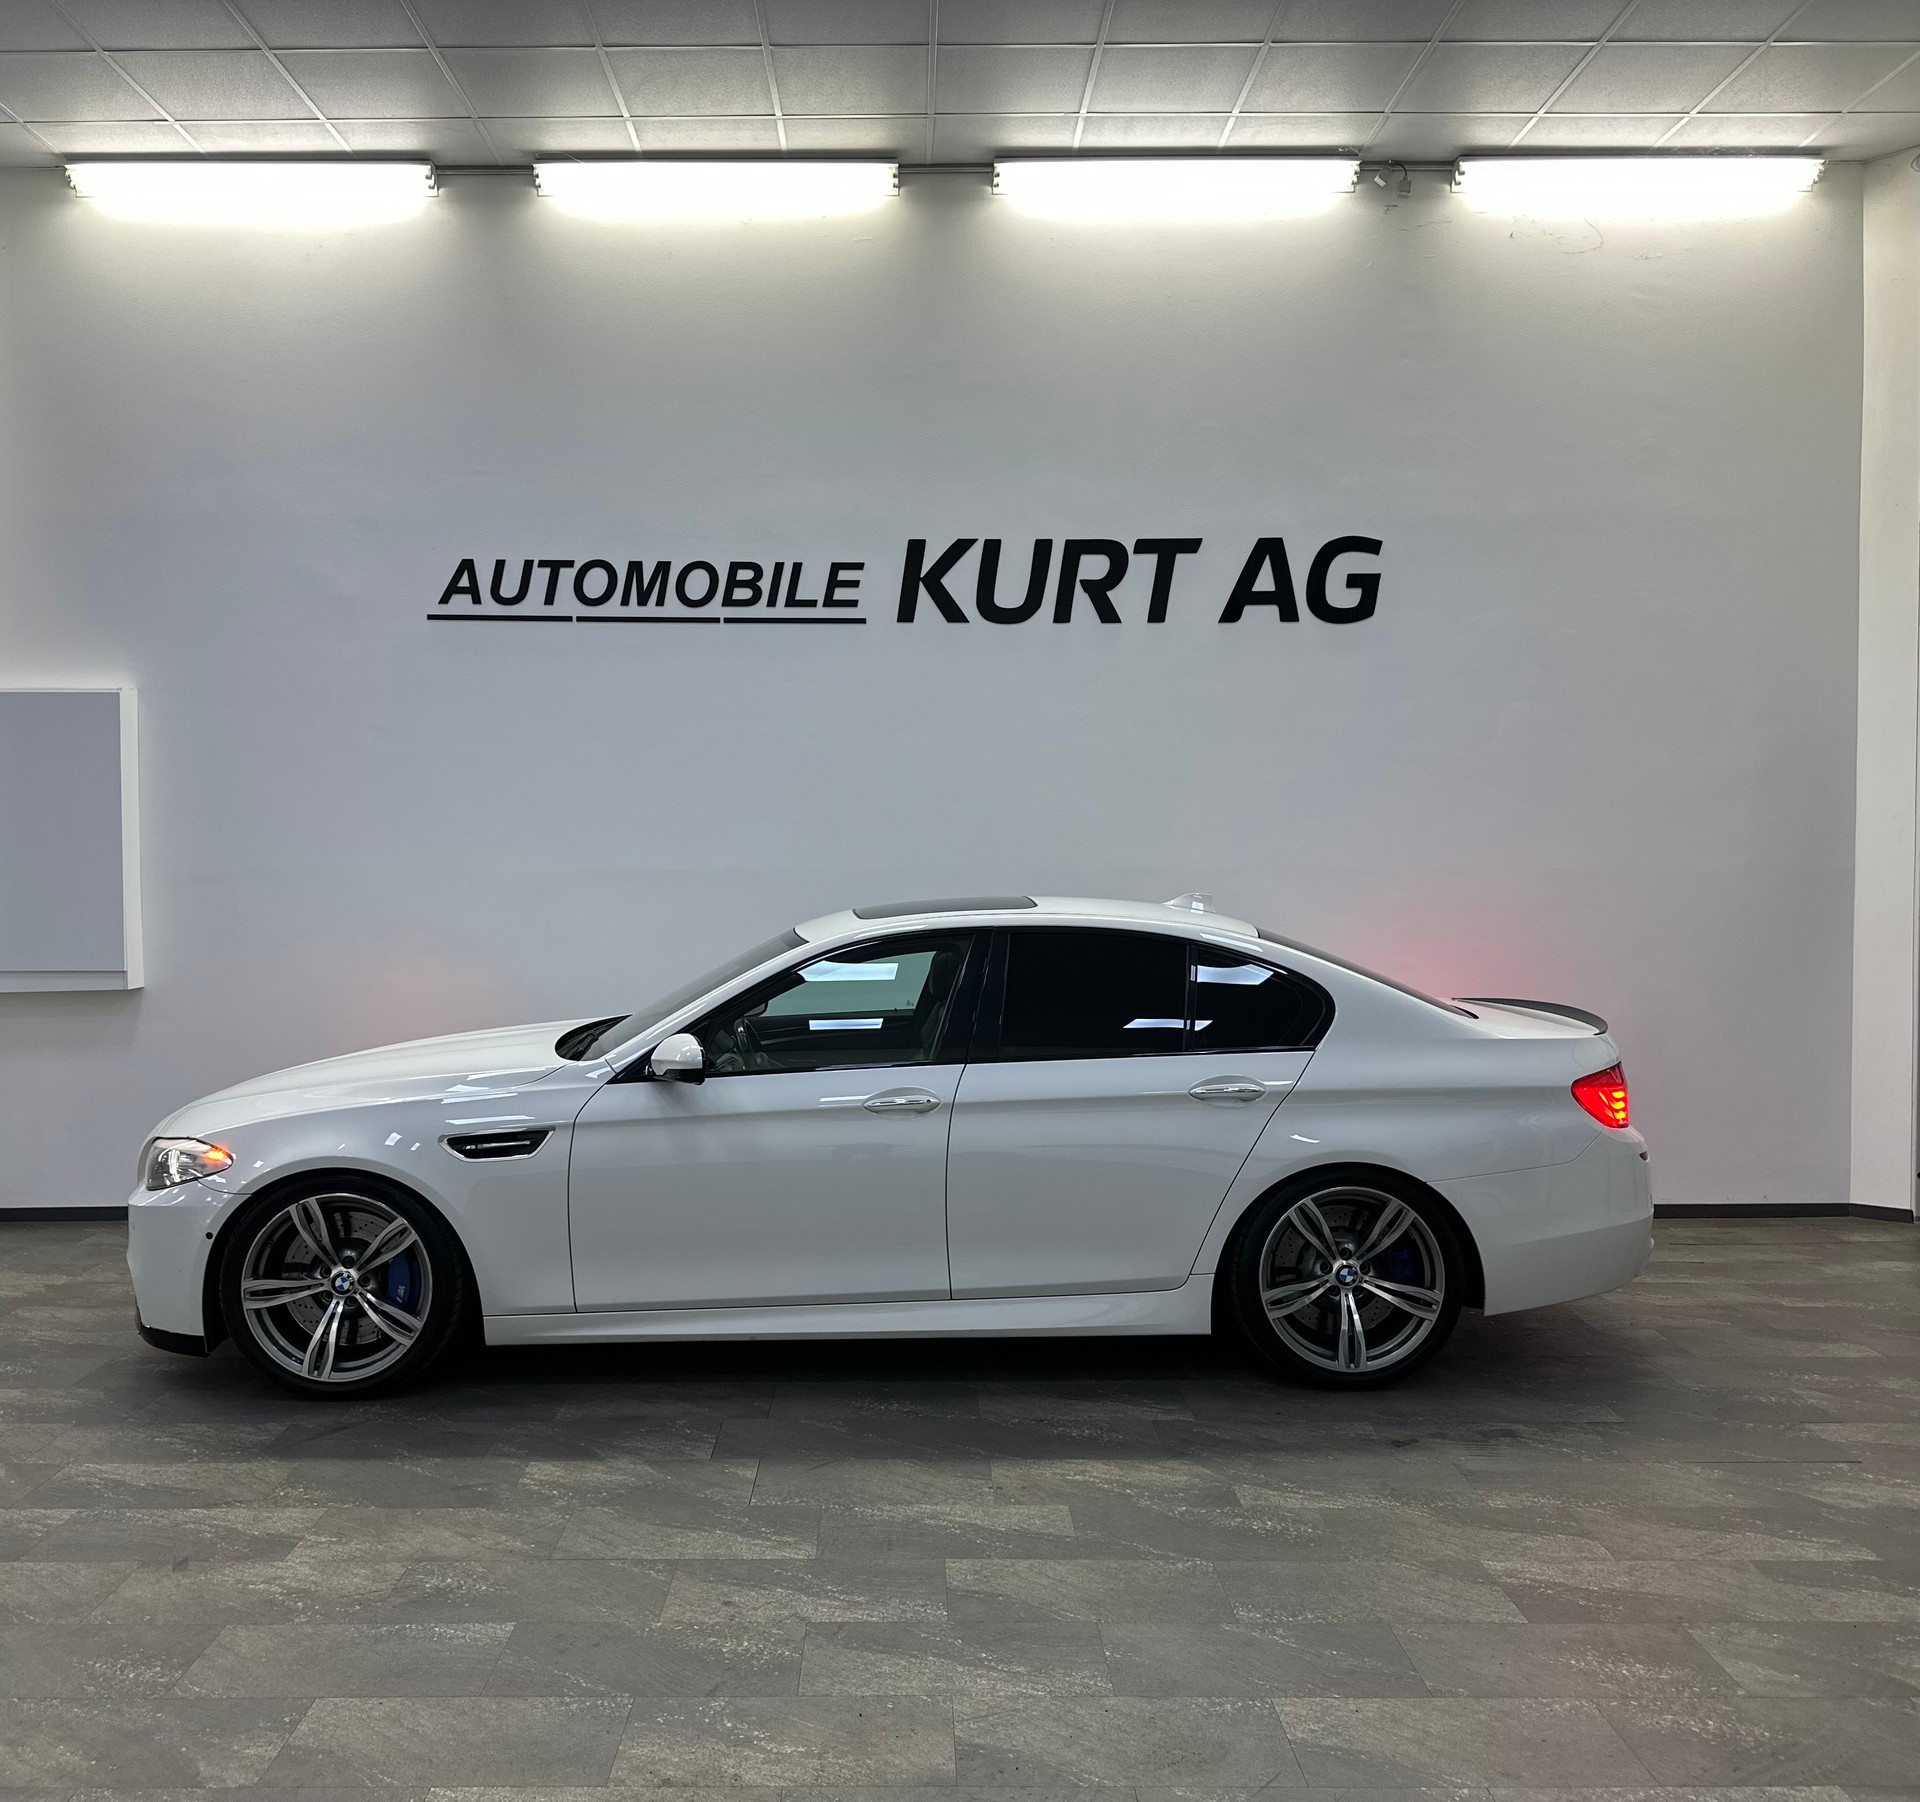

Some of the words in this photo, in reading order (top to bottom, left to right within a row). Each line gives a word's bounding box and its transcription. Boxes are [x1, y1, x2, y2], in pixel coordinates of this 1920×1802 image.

[437, 558, 867, 609] AUTOMOBILE
[896, 537, 1204, 625] KURT
[1217, 535, 1384, 625] AG
